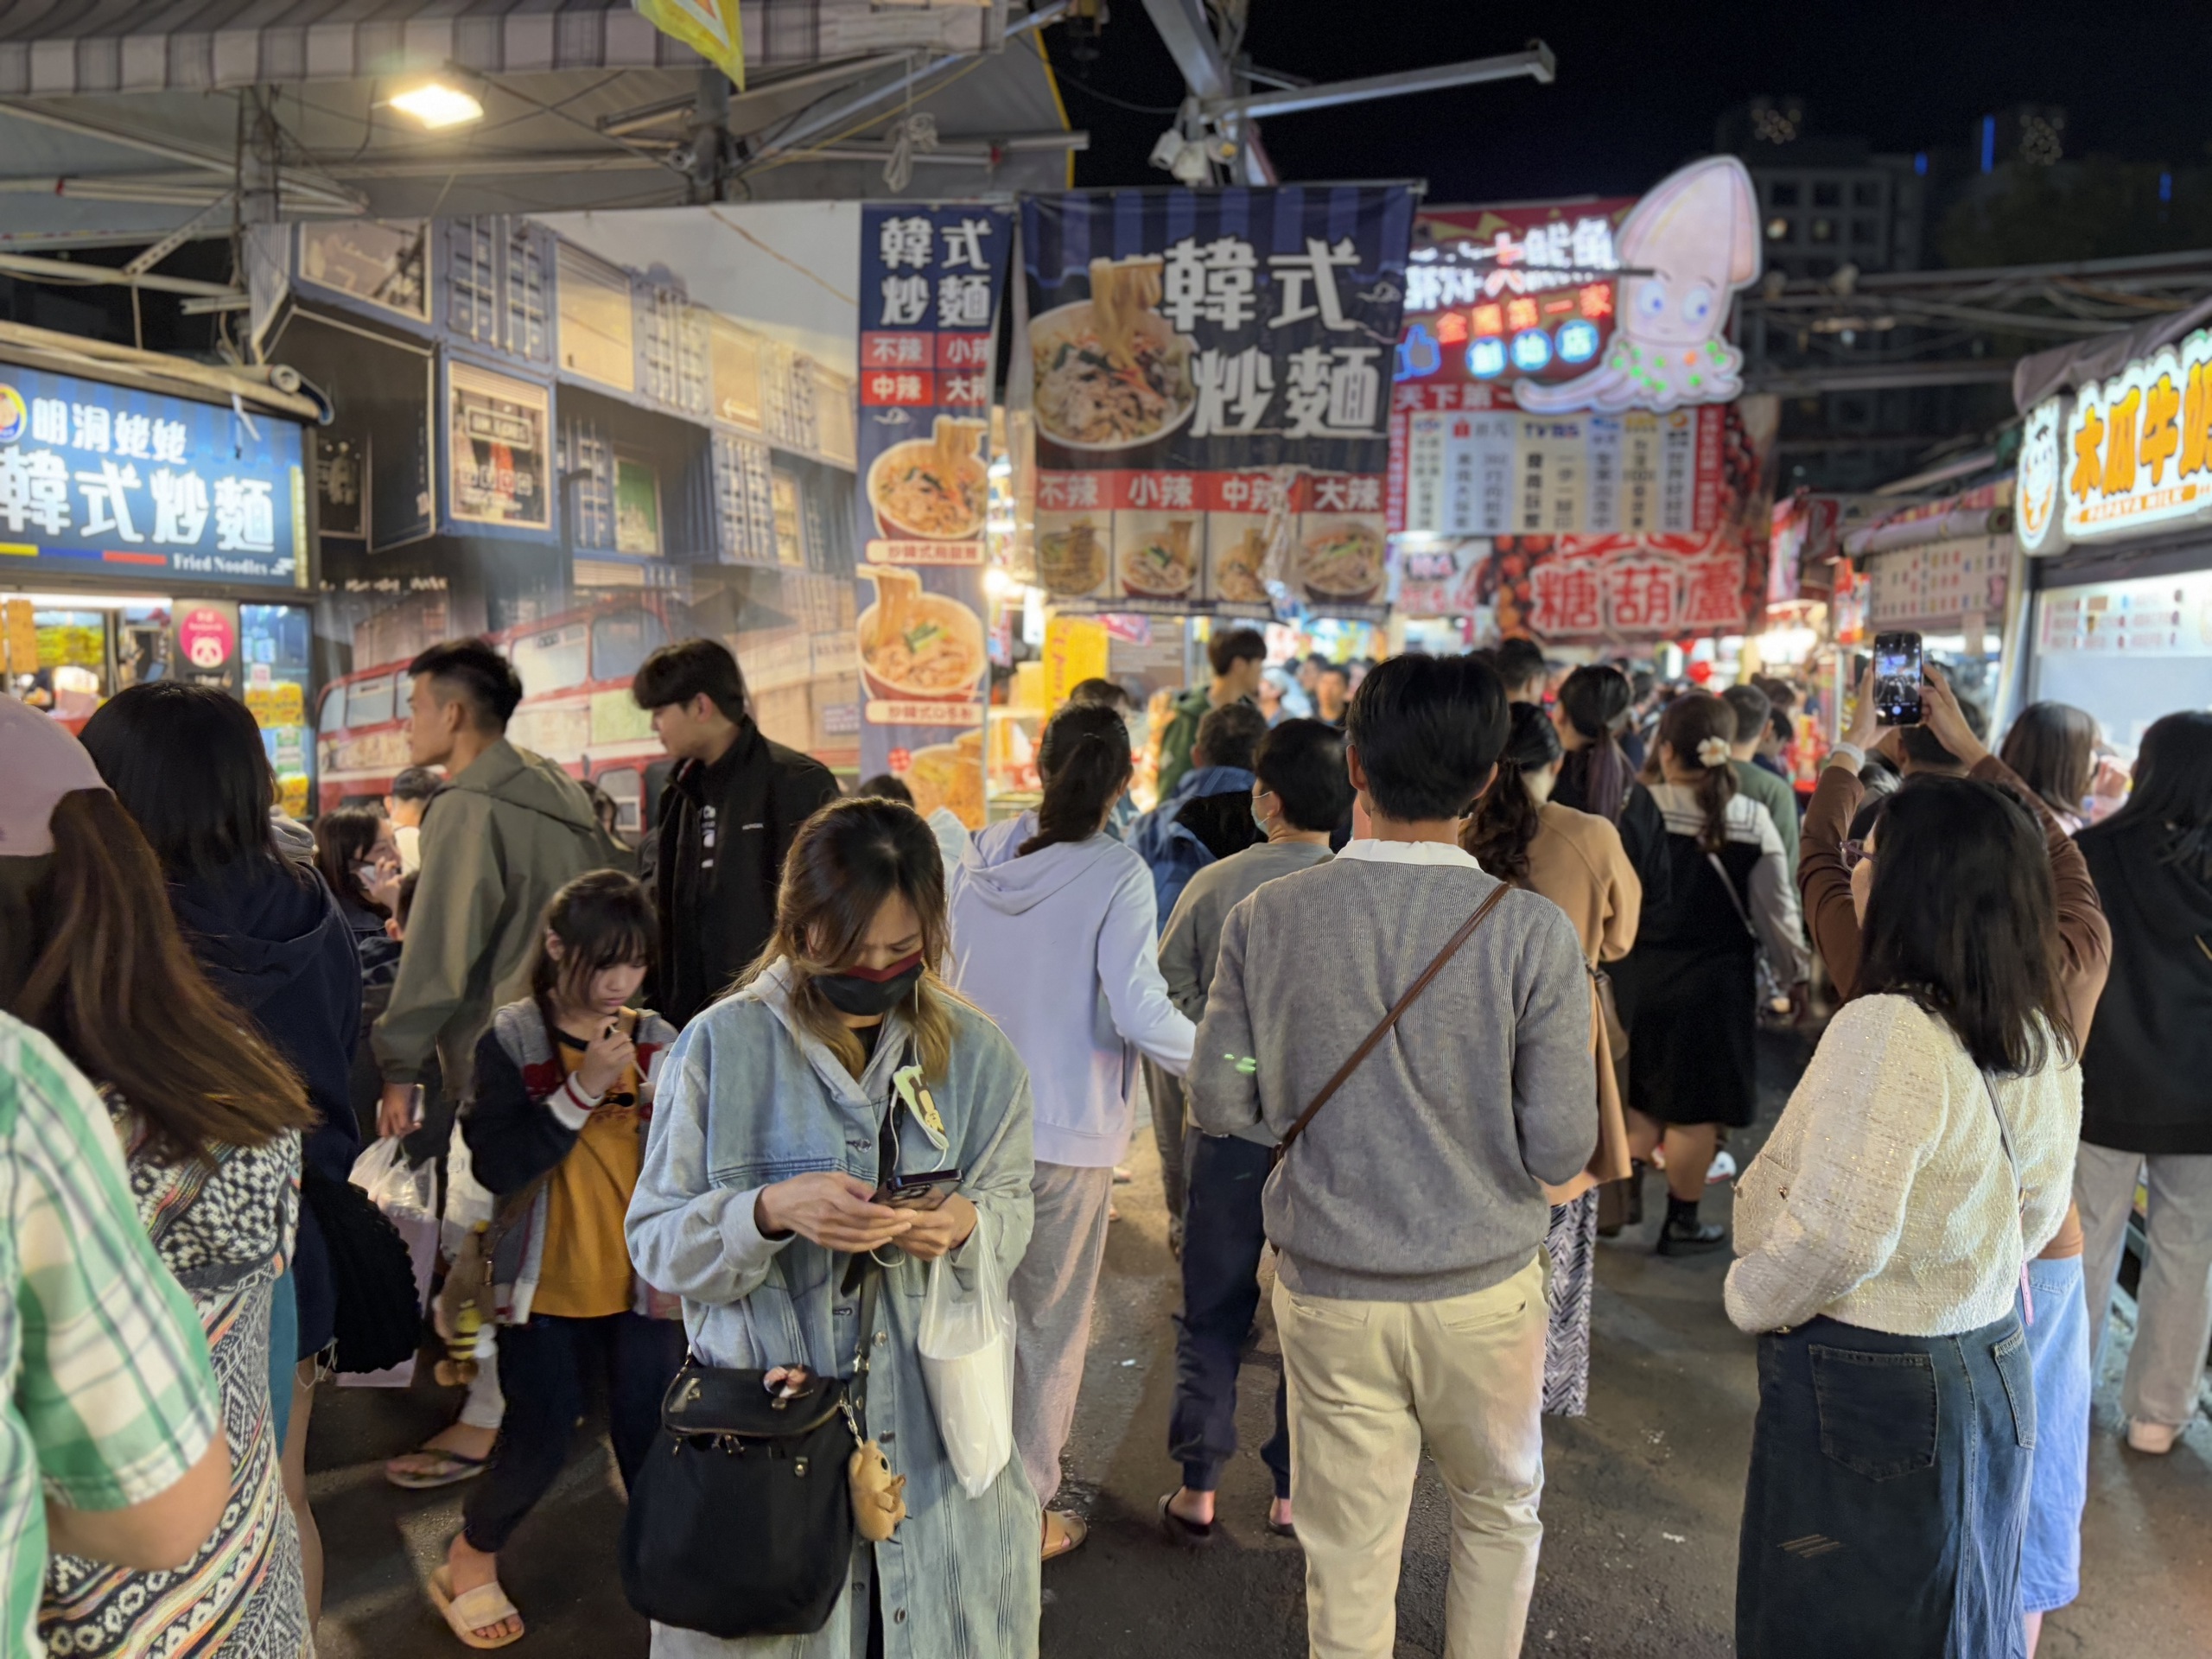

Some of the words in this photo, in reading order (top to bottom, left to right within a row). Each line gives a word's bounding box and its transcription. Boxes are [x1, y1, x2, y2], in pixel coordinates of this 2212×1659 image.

[880, 216, 993, 270] 韓式
[880, 273, 992, 327] 炒麵
[1162, 235, 1362, 333] 韓式
[872, 336, 923, 364] 不辣
[872, 373, 922, 402] 中辣
[1190, 346, 1384, 439] 炒麵
[0, 445, 275, 553] 韓式炒麵
[1039, 474, 1098, 508] 不辣
[1128, 474, 1193, 508] 小辣
[1313, 477, 1381, 511] 大辣
[173, 552, 212, 571] Fried
[213, 556, 268, 576] Noodles
